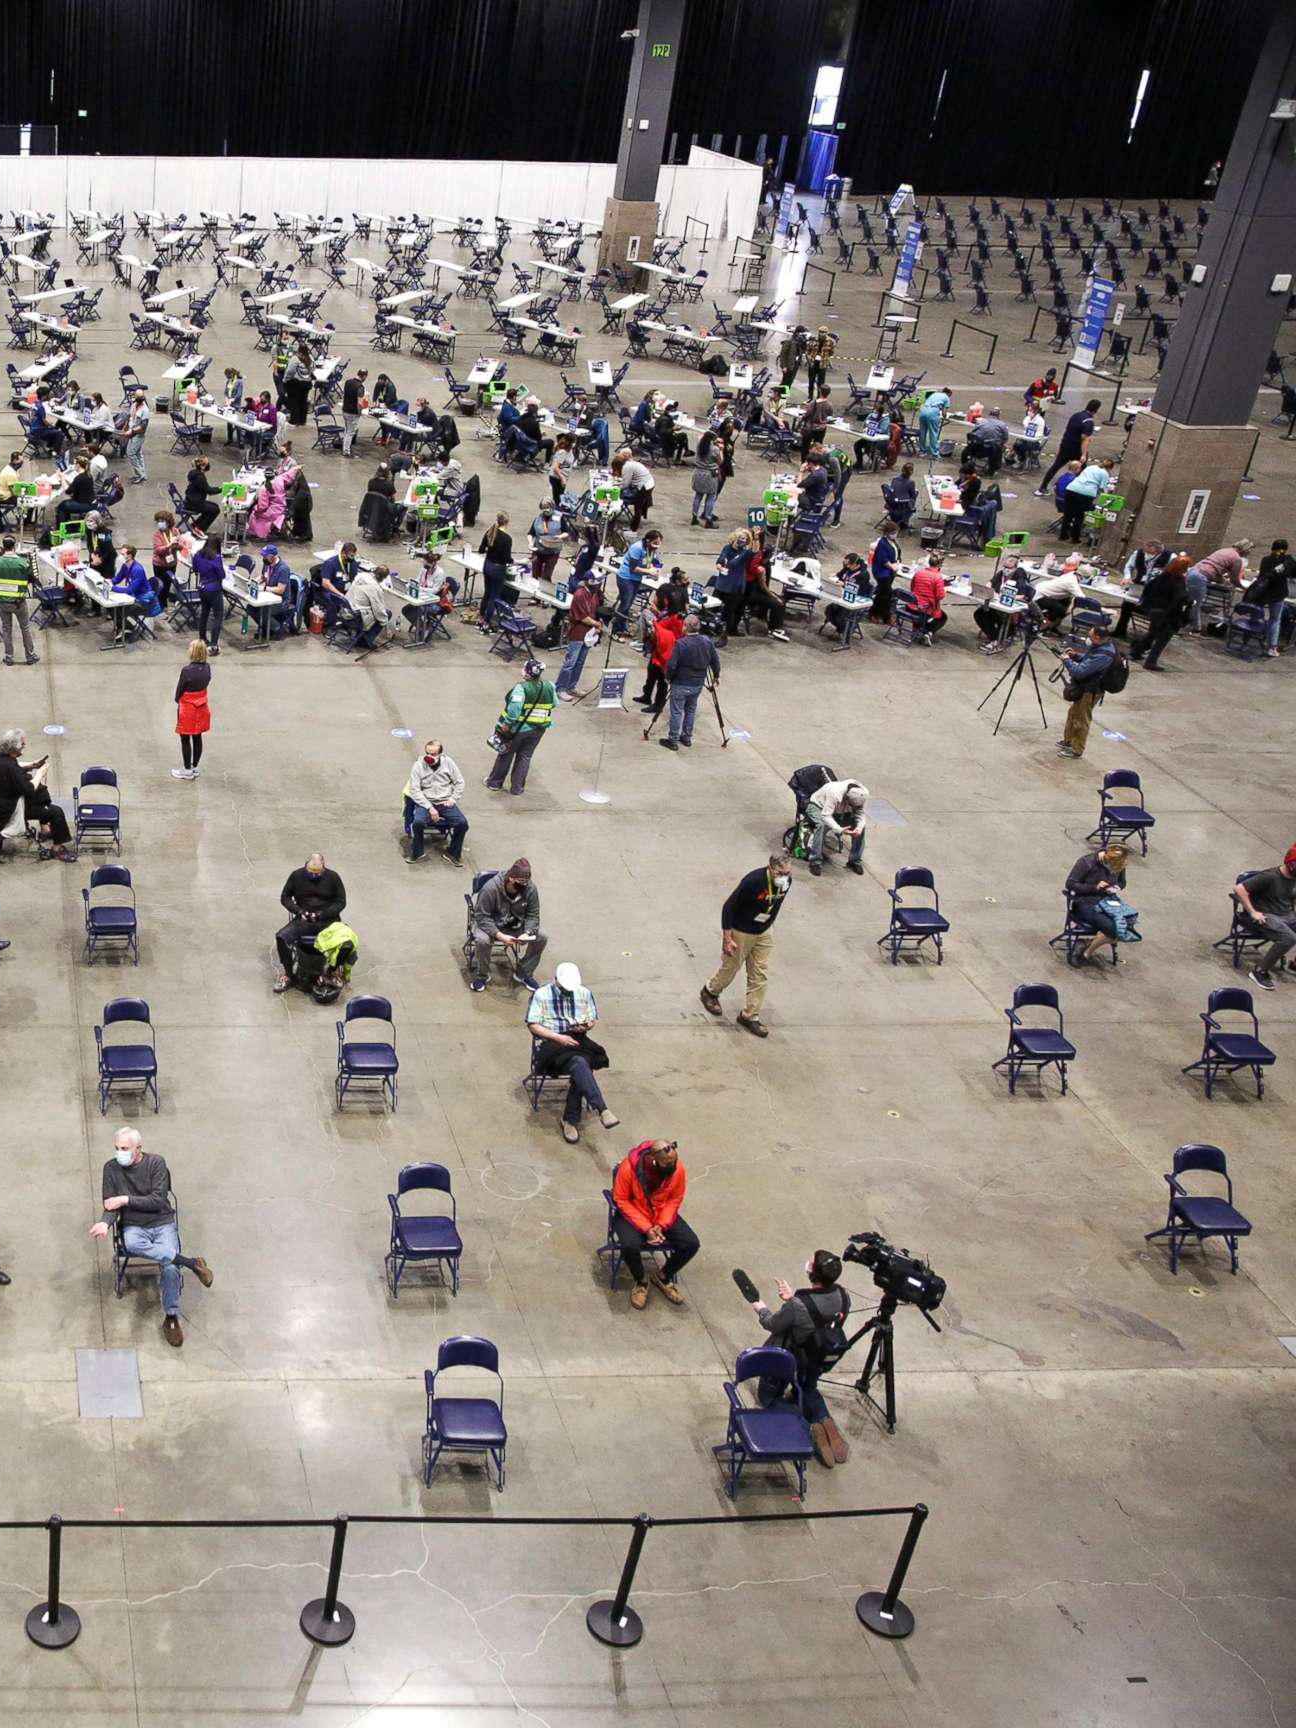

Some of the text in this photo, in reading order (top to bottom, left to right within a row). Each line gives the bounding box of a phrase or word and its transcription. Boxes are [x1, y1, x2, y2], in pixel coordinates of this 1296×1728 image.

[654, 45, 669, 57] 12P
[587, 503, 594, 513] 9
[749, 510, 764, 522] 10
[845, 592, 854, 602] 11
[1002, 595, 1013, 606] 12
